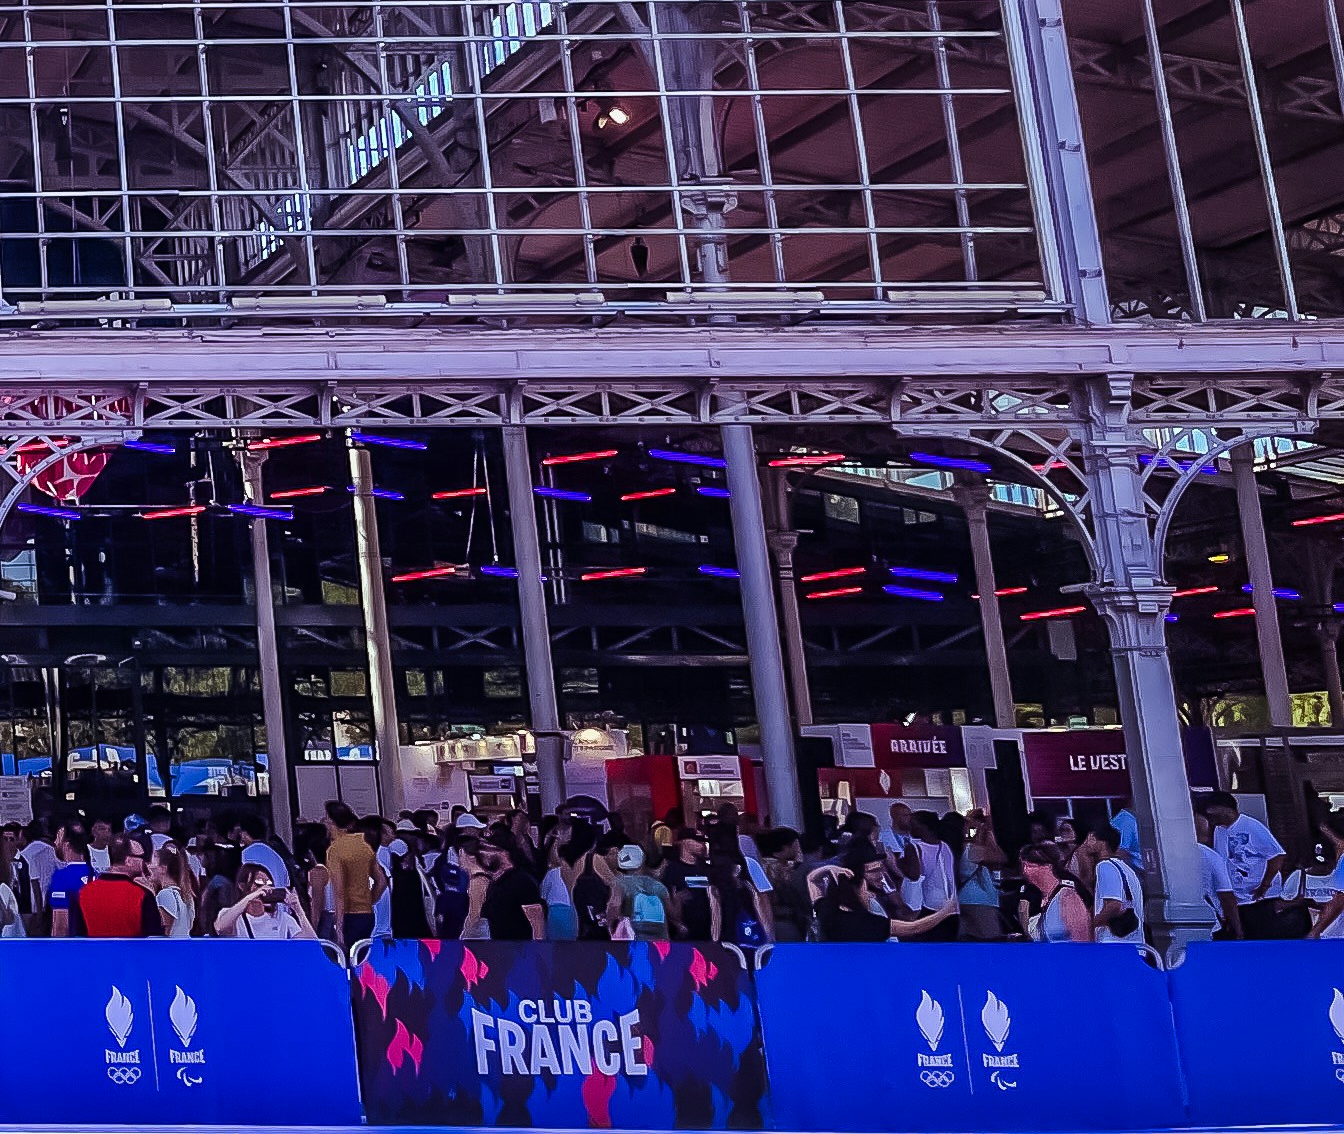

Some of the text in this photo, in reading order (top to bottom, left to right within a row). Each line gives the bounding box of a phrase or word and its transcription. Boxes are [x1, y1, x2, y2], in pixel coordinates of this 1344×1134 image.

[891, 736, 947, 754] ARRIVÉE
[1070, 754, 1127, 770] LE VEST
[519, 1000, 592, 1023] CLUB
[471, 1008, 647, 1075] FRANCE
[105, 1049, 140, 1063] FRANCE
[170, 1049, 205, 1063] FRANCE
